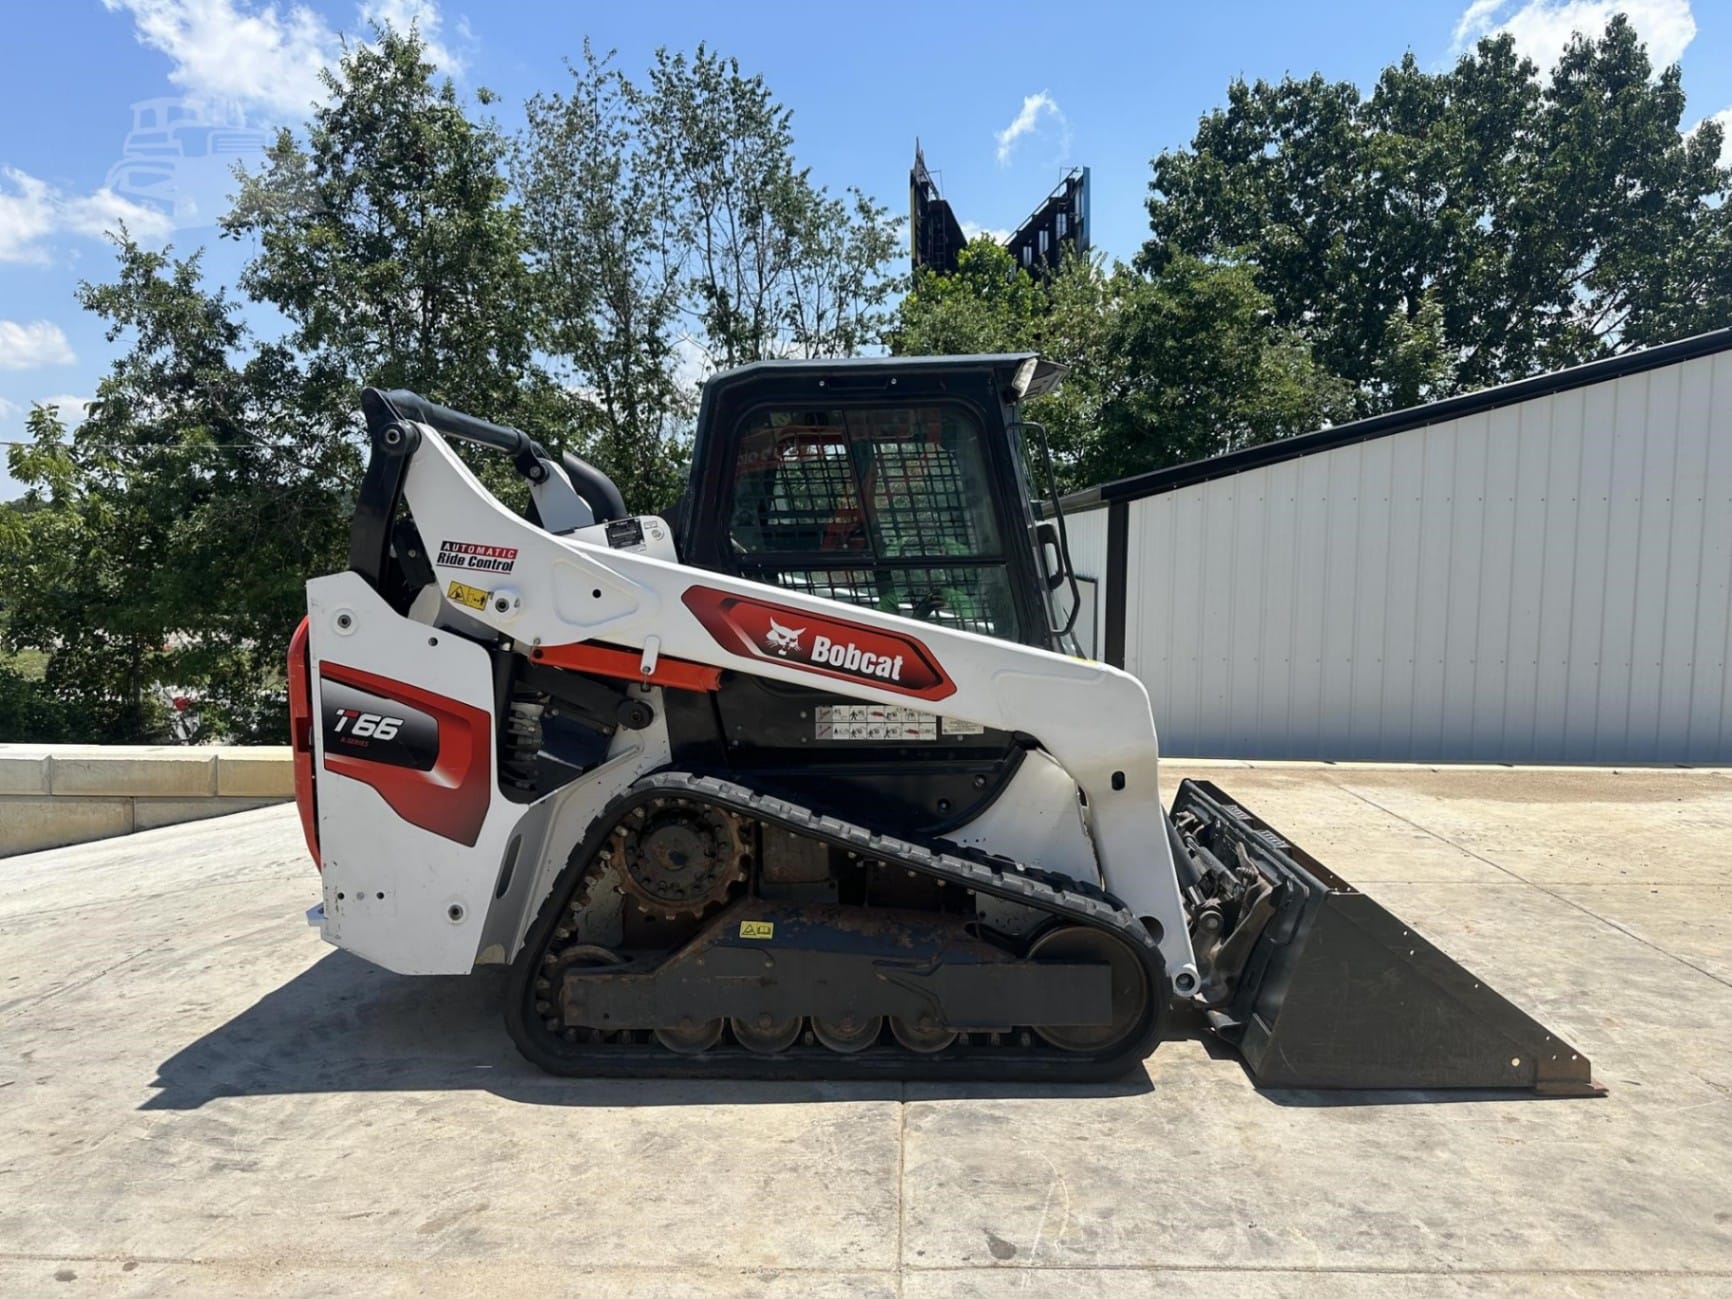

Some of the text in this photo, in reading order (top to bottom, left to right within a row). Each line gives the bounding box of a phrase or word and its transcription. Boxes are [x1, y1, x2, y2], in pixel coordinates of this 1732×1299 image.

[437, 552, 515, 572] Ride Control
[443, 543, 516, 558] AUTOMATIC
[811, 636, 904, 681] Bobcat
[334, 709, 404, 741] T66
